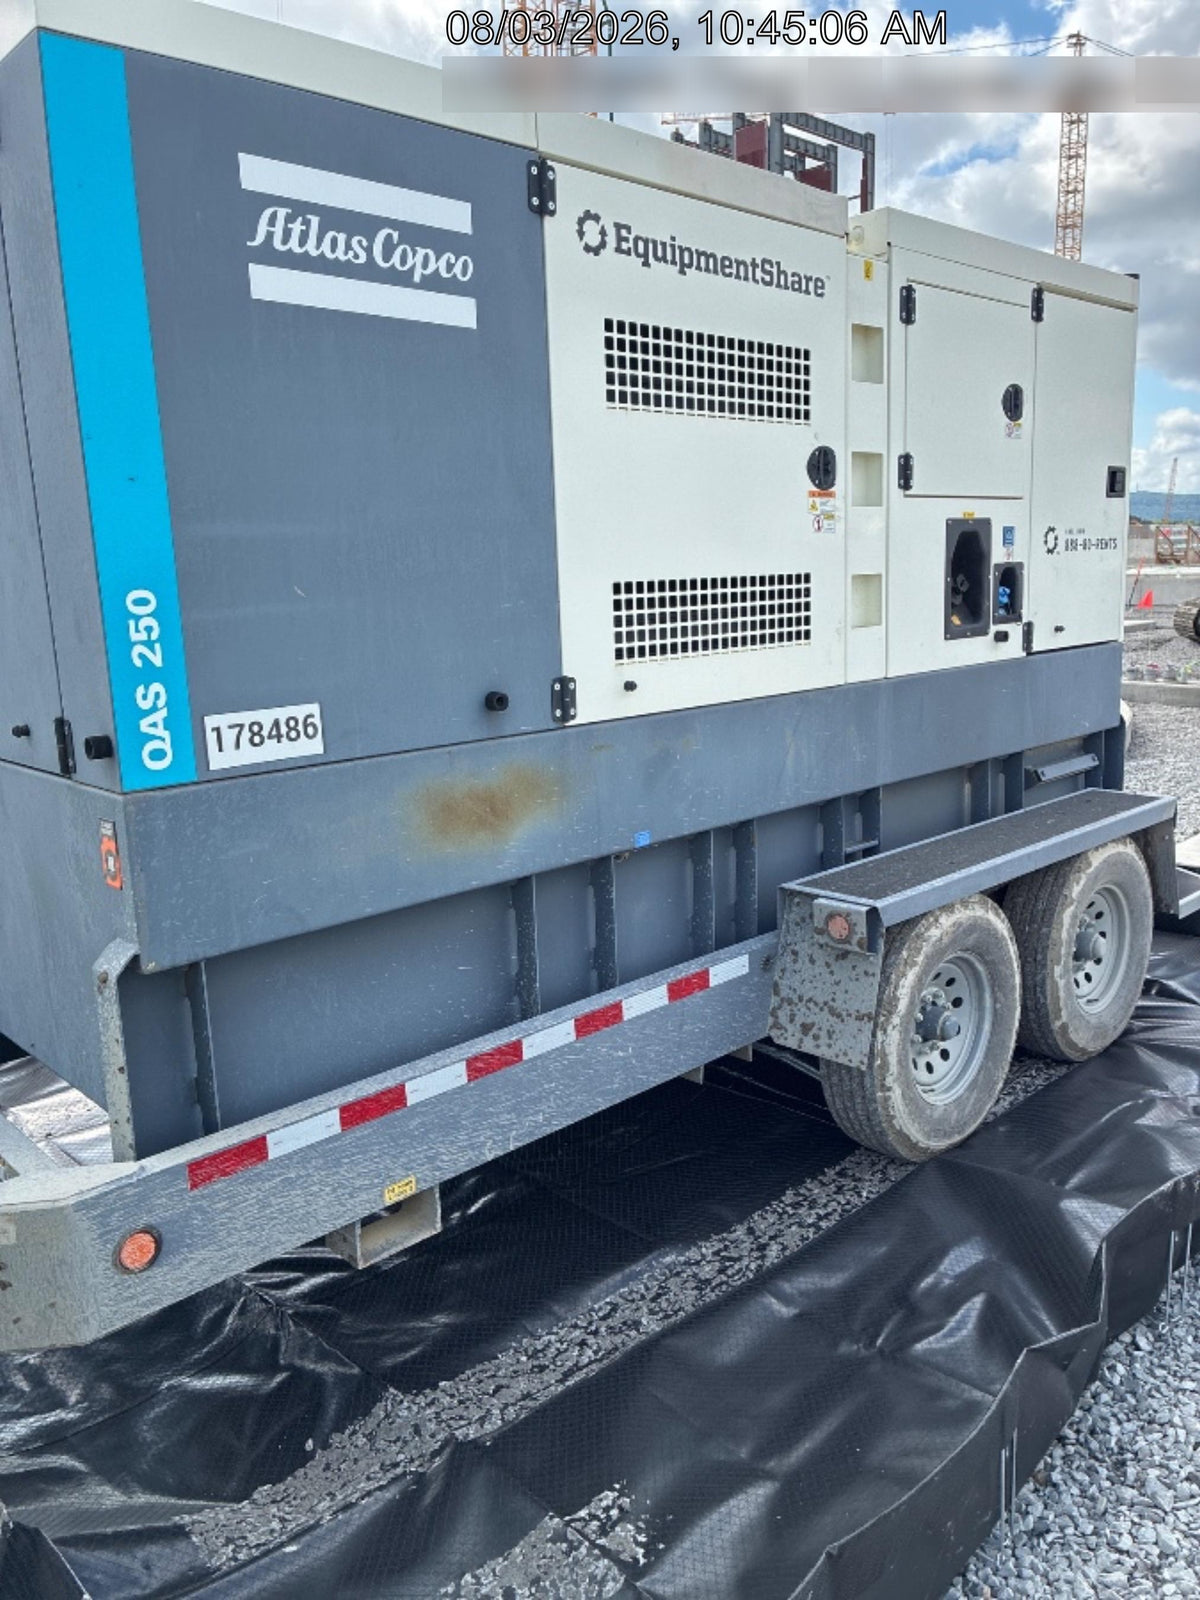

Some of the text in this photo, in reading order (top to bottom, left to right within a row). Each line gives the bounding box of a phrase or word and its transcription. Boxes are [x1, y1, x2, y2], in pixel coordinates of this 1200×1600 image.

[246, 206, 475, 284] Atlas Copco
[613, 220, 826, 299] EquipmentShare
[125, 589, 174, 771] QAS 250
[211, 713, 319, 753] 178486
